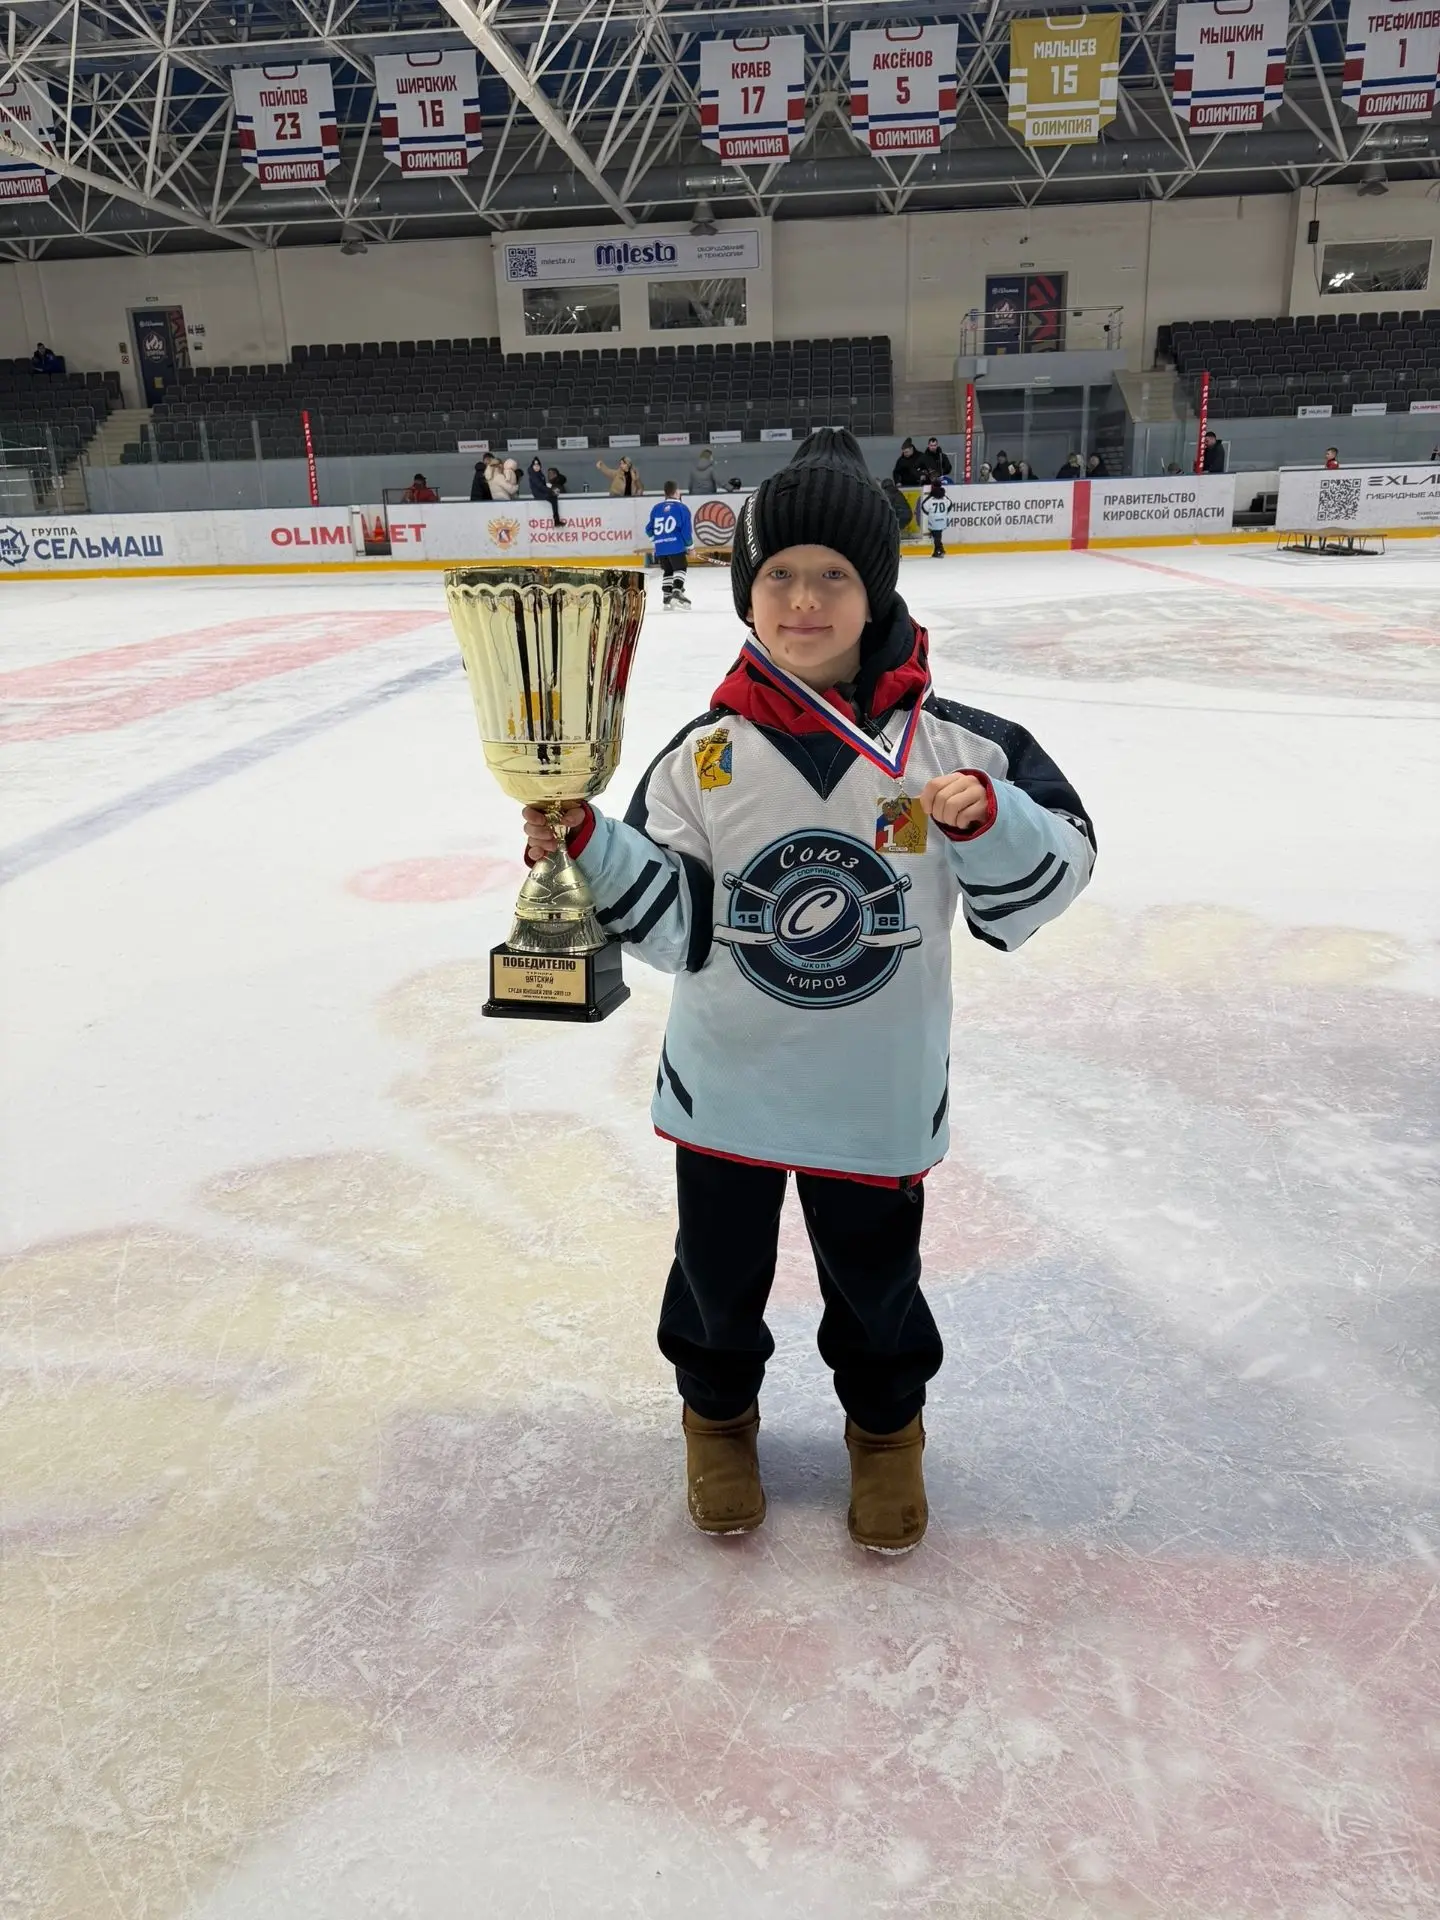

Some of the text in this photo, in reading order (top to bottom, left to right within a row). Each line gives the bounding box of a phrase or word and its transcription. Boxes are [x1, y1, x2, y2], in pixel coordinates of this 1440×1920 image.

[1368, 10, 1440, 33] ТРЕФИЛОВ
[1200, 24, 1263, 45] МЫШКИН
[1033, 37, 1097, 60] МАЛЬЦЕВ
[1399, 38, 1407, 68] 1
[873, 48, 933, 71] АКСЁНОВ
[1226, 50, 1235, 80] 1
[731, 61, 771, 79] КРАЕВ
[1050, 64, 1078, 95] 15
[396, 75, 458, 94] ШИРОКИХ
[896, 76, 911, 104] 5
[259, 86, 308, 108] ПОЙЛОВ
[740, 86, 766, 115] 17
[1365, 92, 1428, 114] ОЛИМПИЯ
[417, 99, 446, 128] 16
[1196, 104, 1258, 124] ОЛИМПИЯ
[273, 112, 302, 140] 23
[1032, 119, 1093, 137] ОЛИМПИЯ
[876, 128, 935, 147] ОЛИМПИЯ
[726, 138, 783, 157] ОЛИМПИЯ
[407, 150, 463, 169] ОЛИМПИЯ
[264, 162, 320, 181] ОЛИМПИЯ
[1104, 492, 1196, 505] ПРАВИТЕЛЬСТВО
[1366, 491, 1426, 500] ГИБРИДНЫЕ
[932, 502, 945, 514] 70
[949, 499, 1064, 512] ИНИСТЕРСТВО СПОРТА
[1103, 507, 1225, 520] КИРОВСКОЙ ОБЛАСТИ
[529, 517, 602, 531] ФЕДРАЦИЯ
[654, 516, 677, 535] 50
[946, 514, 1053, 527] ИРОВСКОЙ ОБЛАСТИ
[31, 527, 77, 537] ГРУППА
[271, 524, 426, 546] OLIMET
[530, 530, 633, 543] ХОККЕЯ РОССИИ
[33, 535, 164, 559] СЕЛЬМАШ
[883, 825, 896, 847] 1
[797, 867, 841, 878] СПОРТИВНАЯ
[738, 914, 899, 926] 19 85
[503, 957, 576, 970] ПОБЕДИТЕЛЮ
[801, 961, 832, 969] ШКОЛА
[786, 973, 847, 990] КИРОВ
